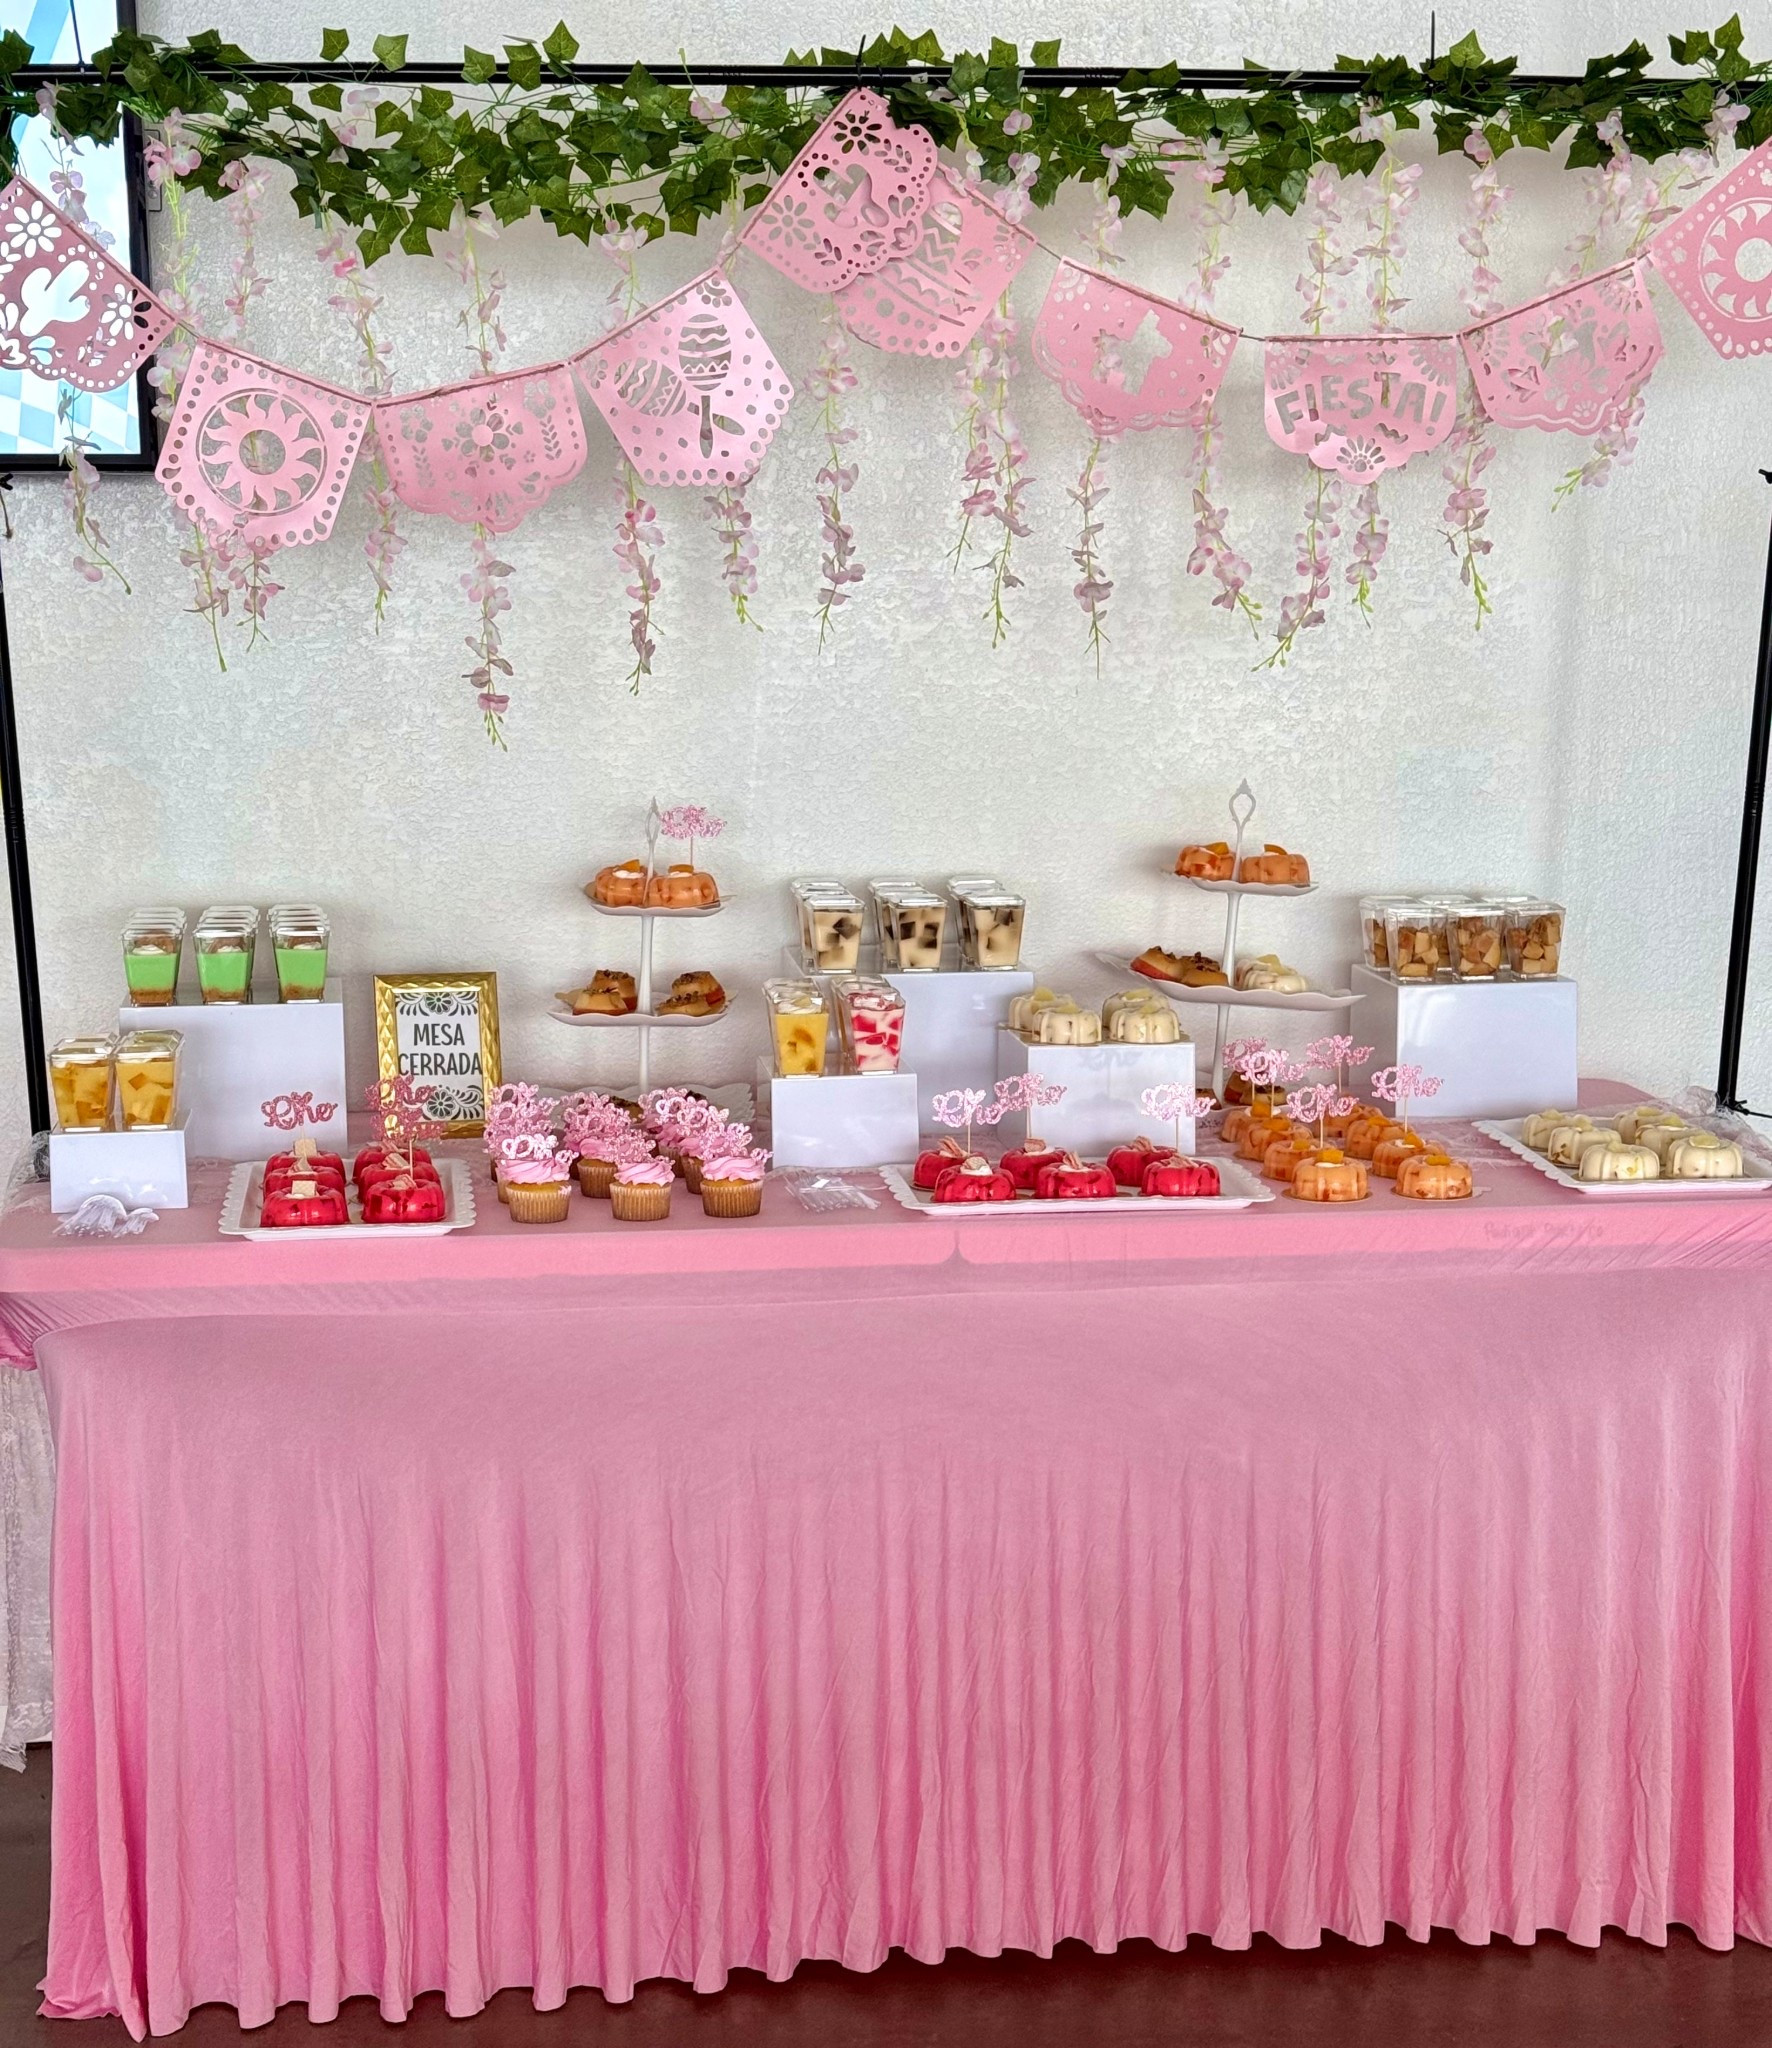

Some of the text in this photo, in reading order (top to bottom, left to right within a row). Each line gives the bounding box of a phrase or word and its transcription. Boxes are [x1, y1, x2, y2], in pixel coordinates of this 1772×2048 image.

[1274, 371, 1447, 436] FIESTA!
[413, 1023, 465, 1047] MESA
[398, 1052, 483, 1076] CERRADA
